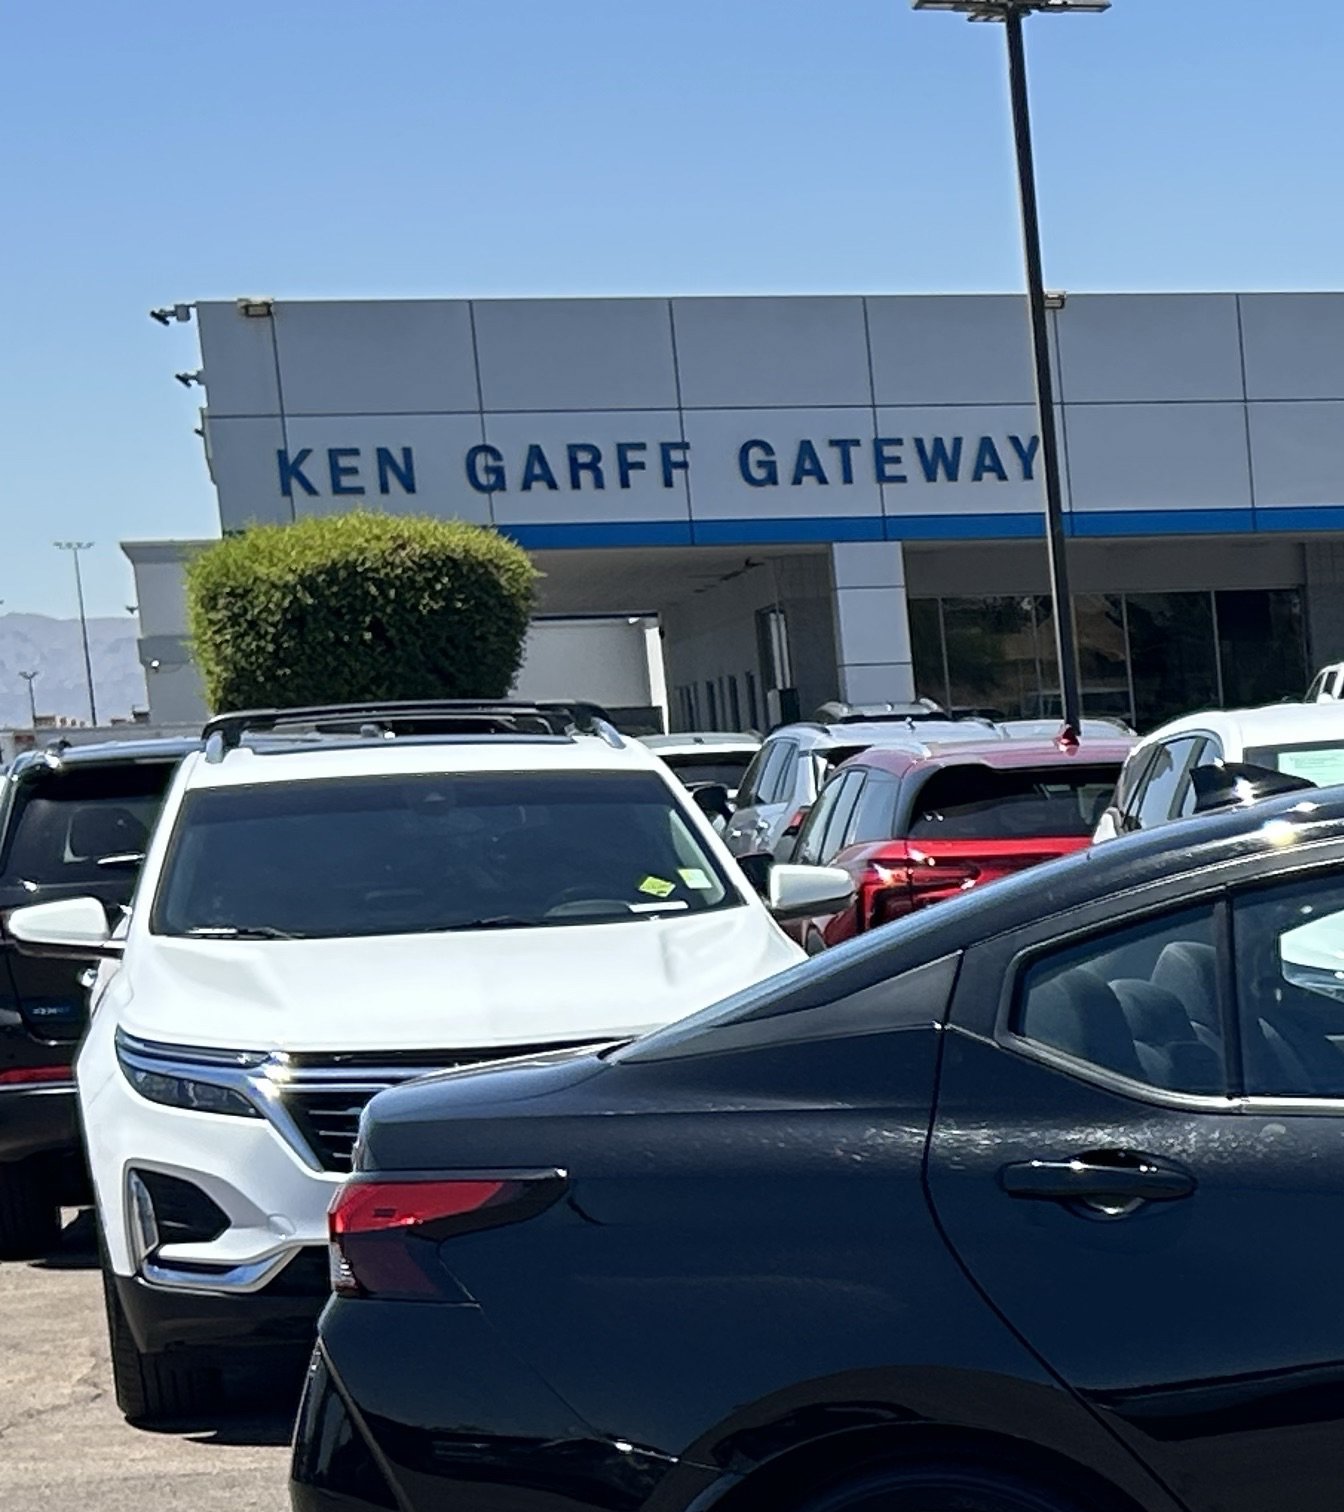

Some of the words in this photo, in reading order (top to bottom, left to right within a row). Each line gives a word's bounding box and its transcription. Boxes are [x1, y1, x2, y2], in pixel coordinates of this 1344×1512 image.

[276, 446, 417, 497] KEN
[465, 442, 691, 493] GARFF
[738, 434, 1040, 487] GATEWAY
